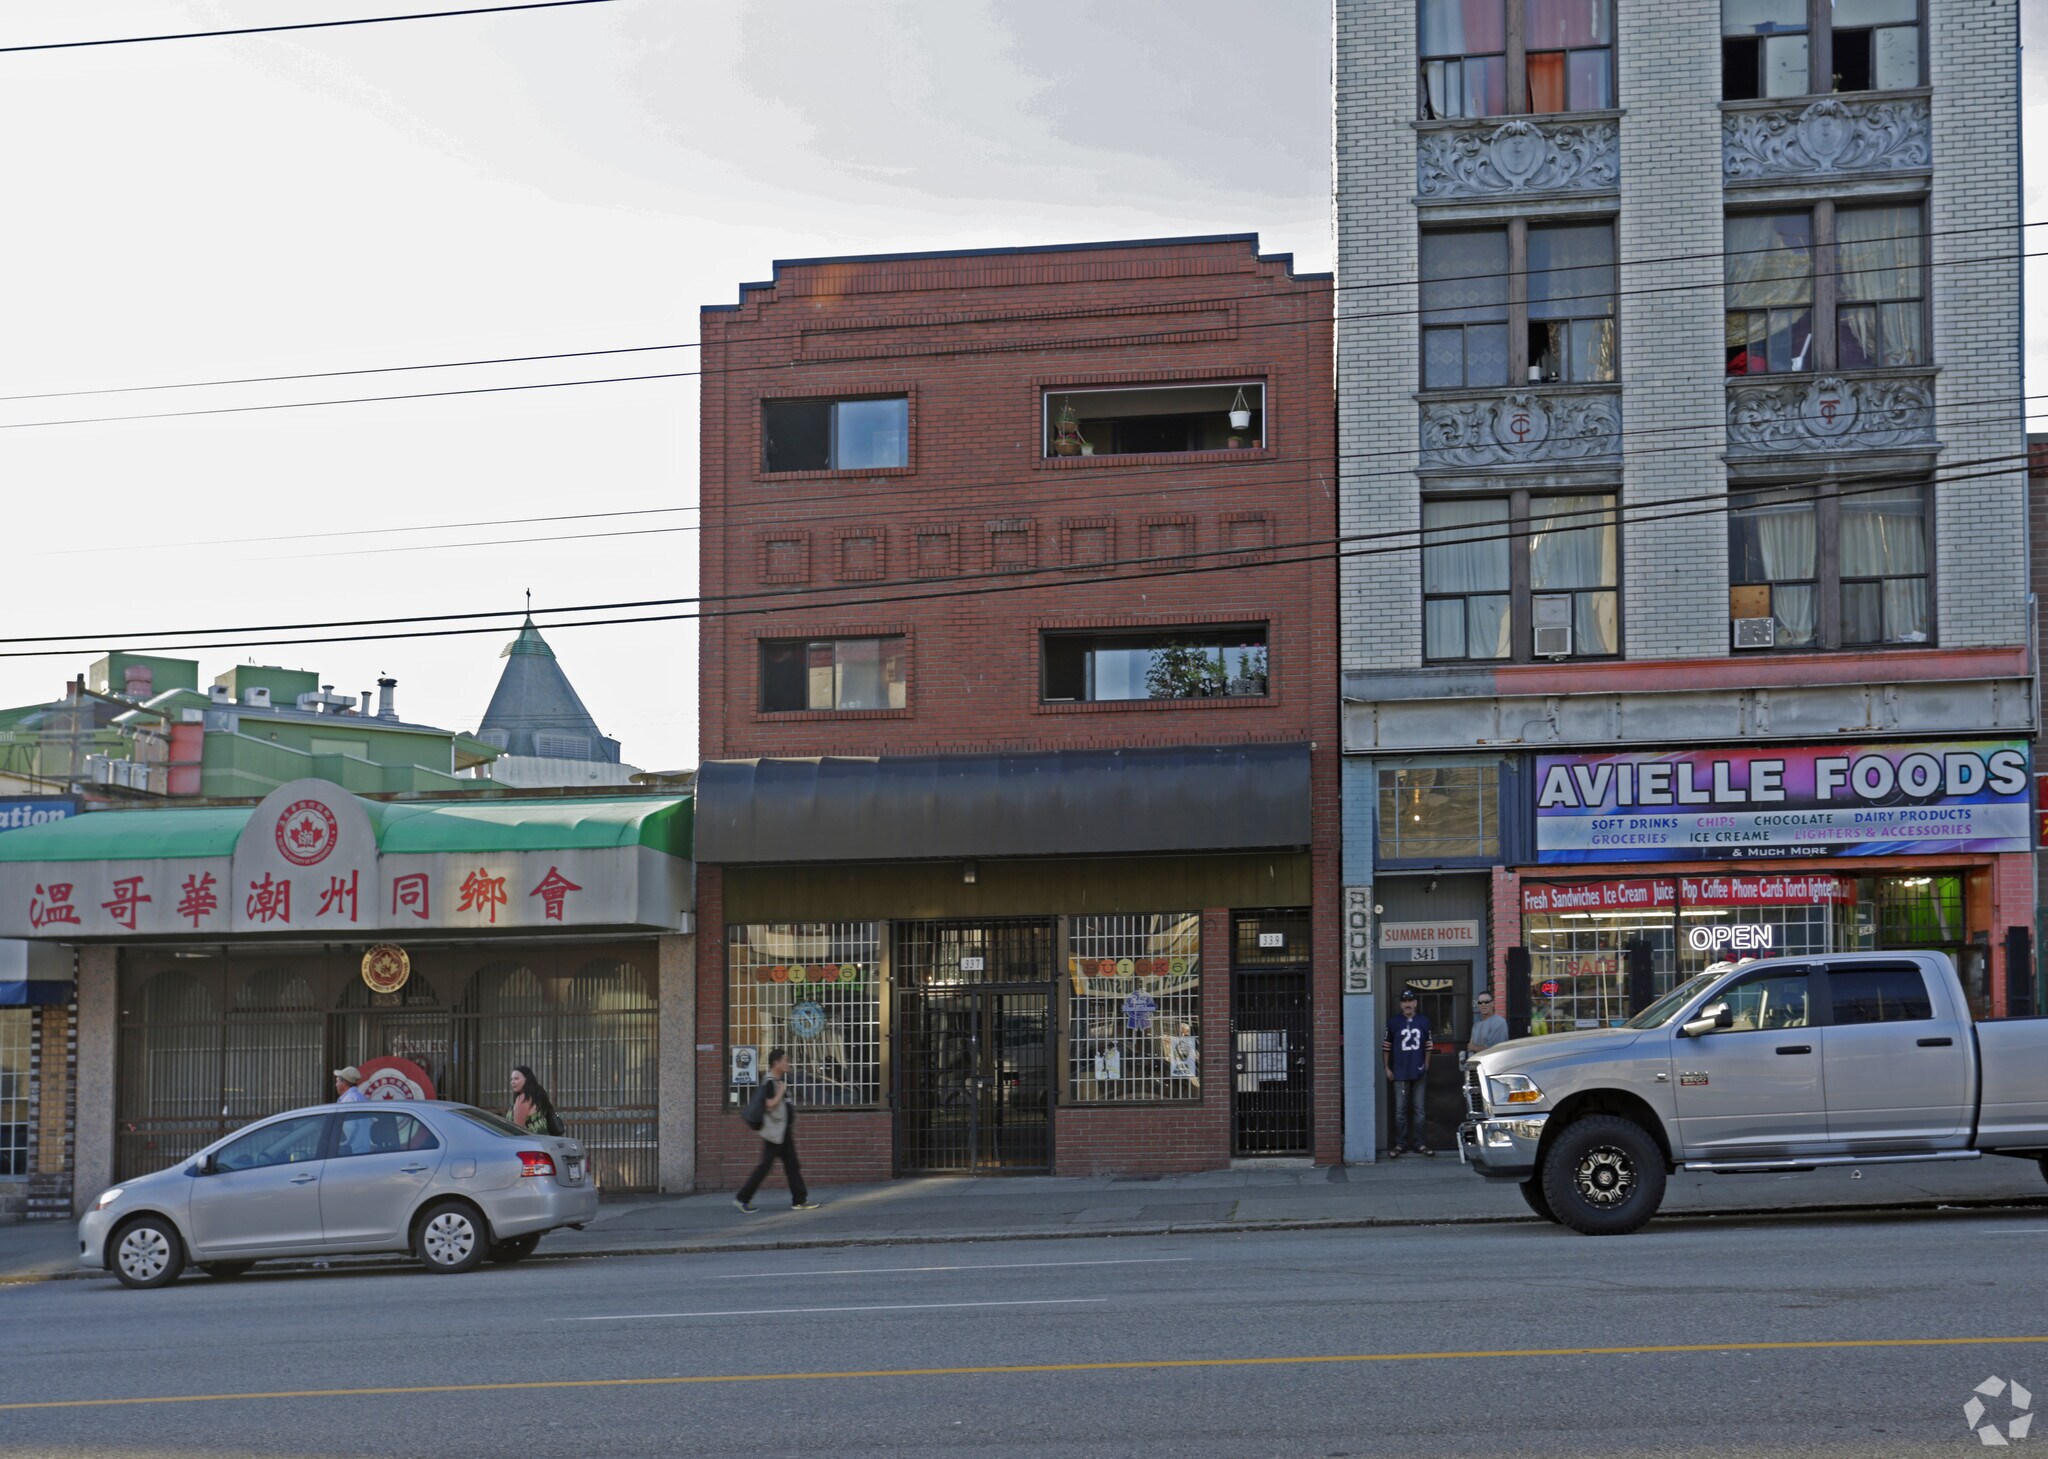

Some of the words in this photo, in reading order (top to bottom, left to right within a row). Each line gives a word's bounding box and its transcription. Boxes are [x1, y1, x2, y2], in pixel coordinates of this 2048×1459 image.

[1537, 759, 1787, 808] AVIELLE
[1814, 750, 2027, 800] FOODS
[1592, 819, 1625, 830] SOFT
[1630, 818, 1678, 829] DRINKS
[1697, 816, 1736, 828] CHIPS
[1754, 814, 1833, 826] CHOCOLATE
[1854, 811, 1895, 823] DAIRY
[1900, 809, 1972, 821] PRODUCTS
[1592, 833, 1668, 845] GROCERIES
[1690, 832, 1710, 843] ICE
[1715, 831, 1770, 842] CREAME
[1795, 828, 1861, 840] LIGHTERS
[1866, 827, 1876, 838] &
[1881, 824, 1972, 837] ACCESSORIES
[1732, 848, 1742, 857] &
[1524, 890, 1548, 910] Fresh
[1551, 886, 1600, 908] Sandwiches
[1603, 884, 1617, 904] Ice
[1618, 883, 1648, 903] Cream
[1682, 879, 1698, 904] Pop
[1702, 878, 1728, 899] Coffee
[1732, 878, 1757, 898] Phone
[1759, 878, 1783, 898] Cards
[1783, 878, 1807, 898] Torch
[1263, 935, 1280, 946] 339
[1351, 891, 1367, 990] ROOMS
[1385, 928, 1435, 941] SUMMER
[1438, 926, 1473, 940] HOTEL
[1689, 925, 1772, 951] OPEN
[964, 958, 981, 969] 337
[1413, 948, 1435, 960] 341
[1401, 1028, 1421, 1051] 23
